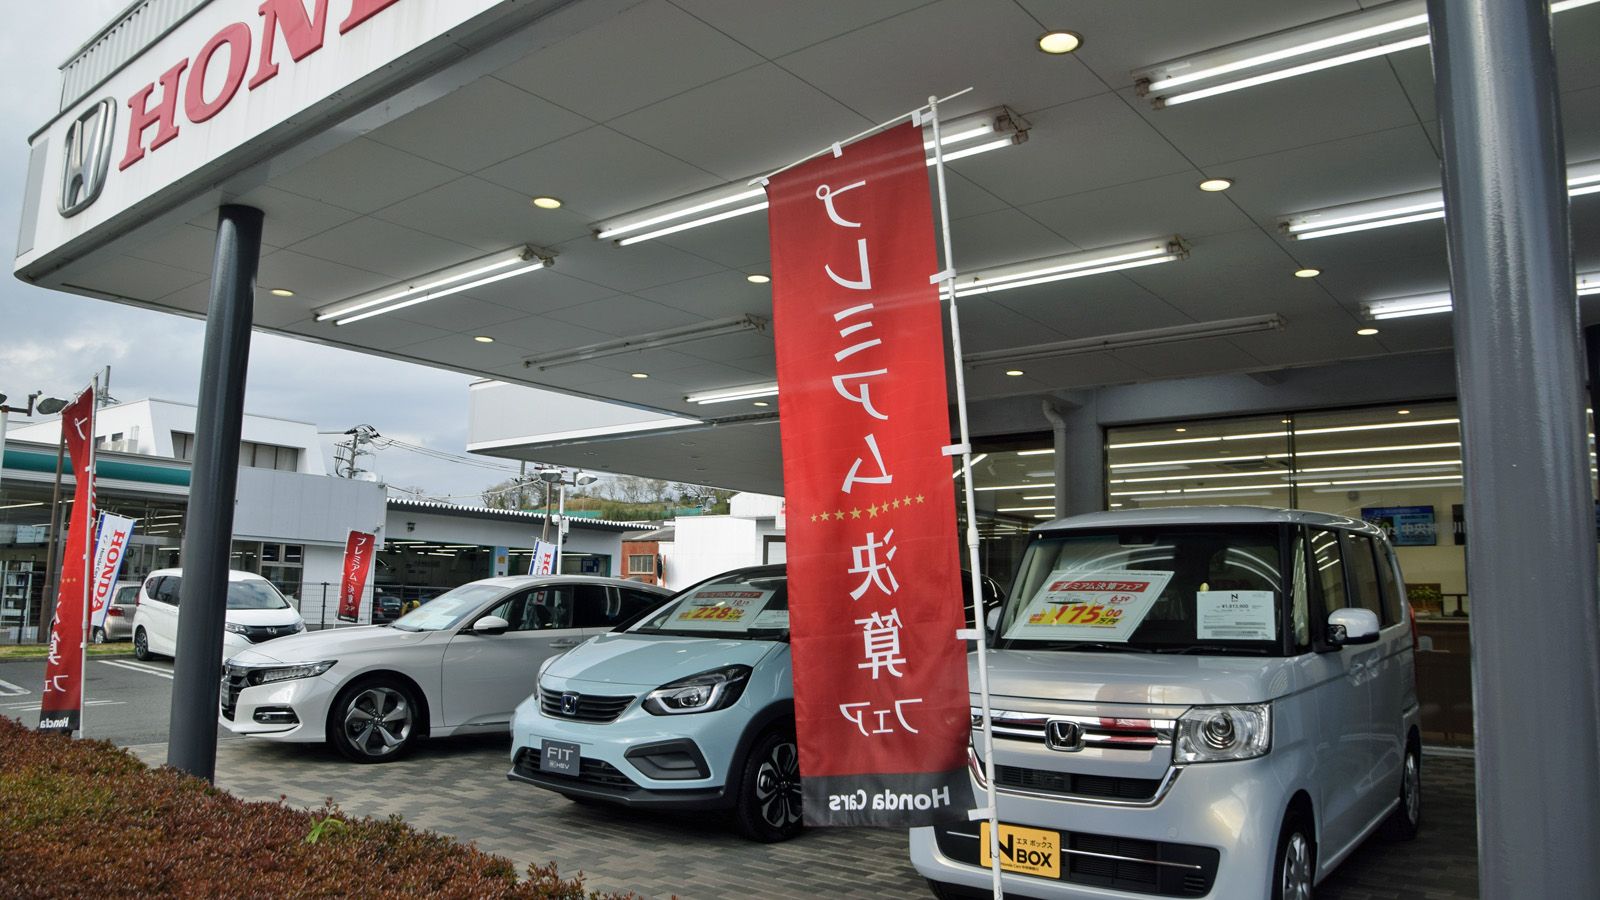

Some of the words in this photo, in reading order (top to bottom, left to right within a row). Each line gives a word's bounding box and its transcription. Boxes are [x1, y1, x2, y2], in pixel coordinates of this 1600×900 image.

[119, 0, 400, 172] HON
[92, 529, 126, 612] HONDA
[547, 746, 574, 761] FIT
[1016, 848, 1052, 868] BOX
